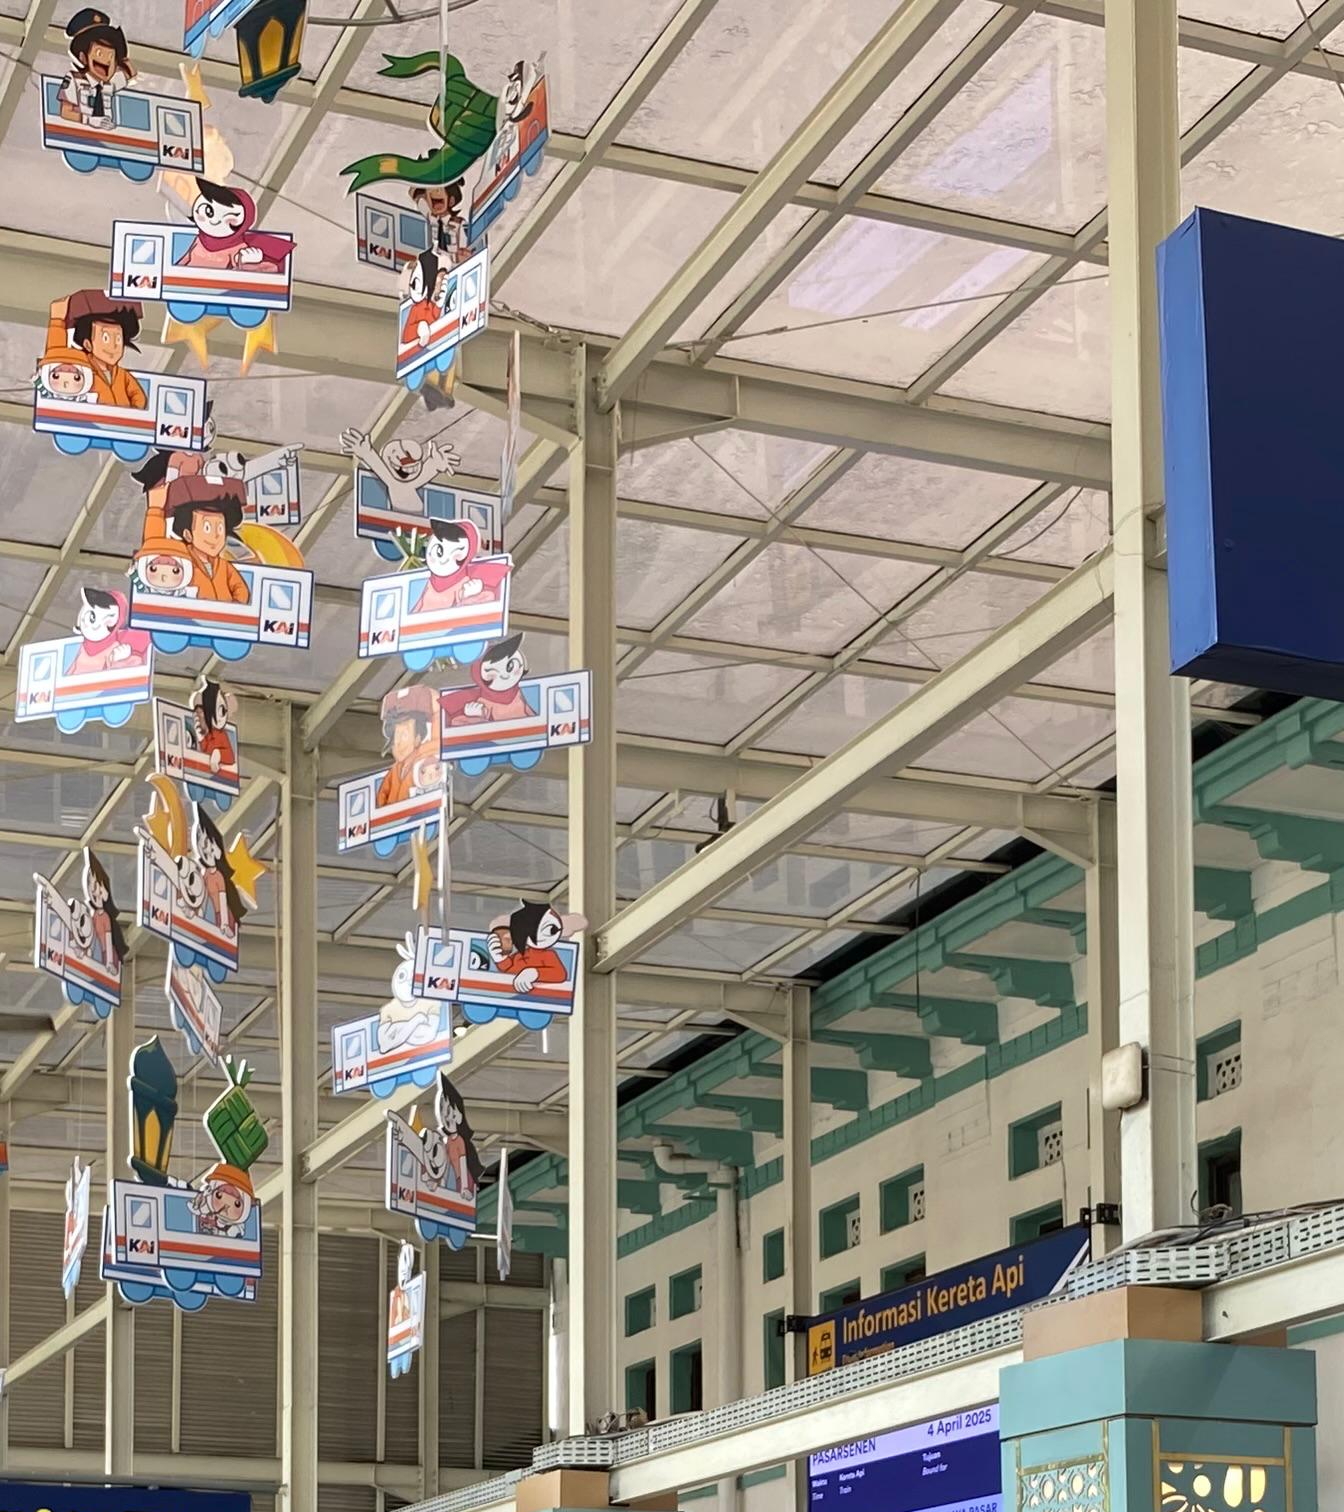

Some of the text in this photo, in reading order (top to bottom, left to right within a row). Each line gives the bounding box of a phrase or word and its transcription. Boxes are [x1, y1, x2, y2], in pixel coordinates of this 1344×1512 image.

[842, 1254, 1025, 1344] Informasi Kereta Api
[812, 1408, 992, 1466] PASARSENEN 4 April 2025
